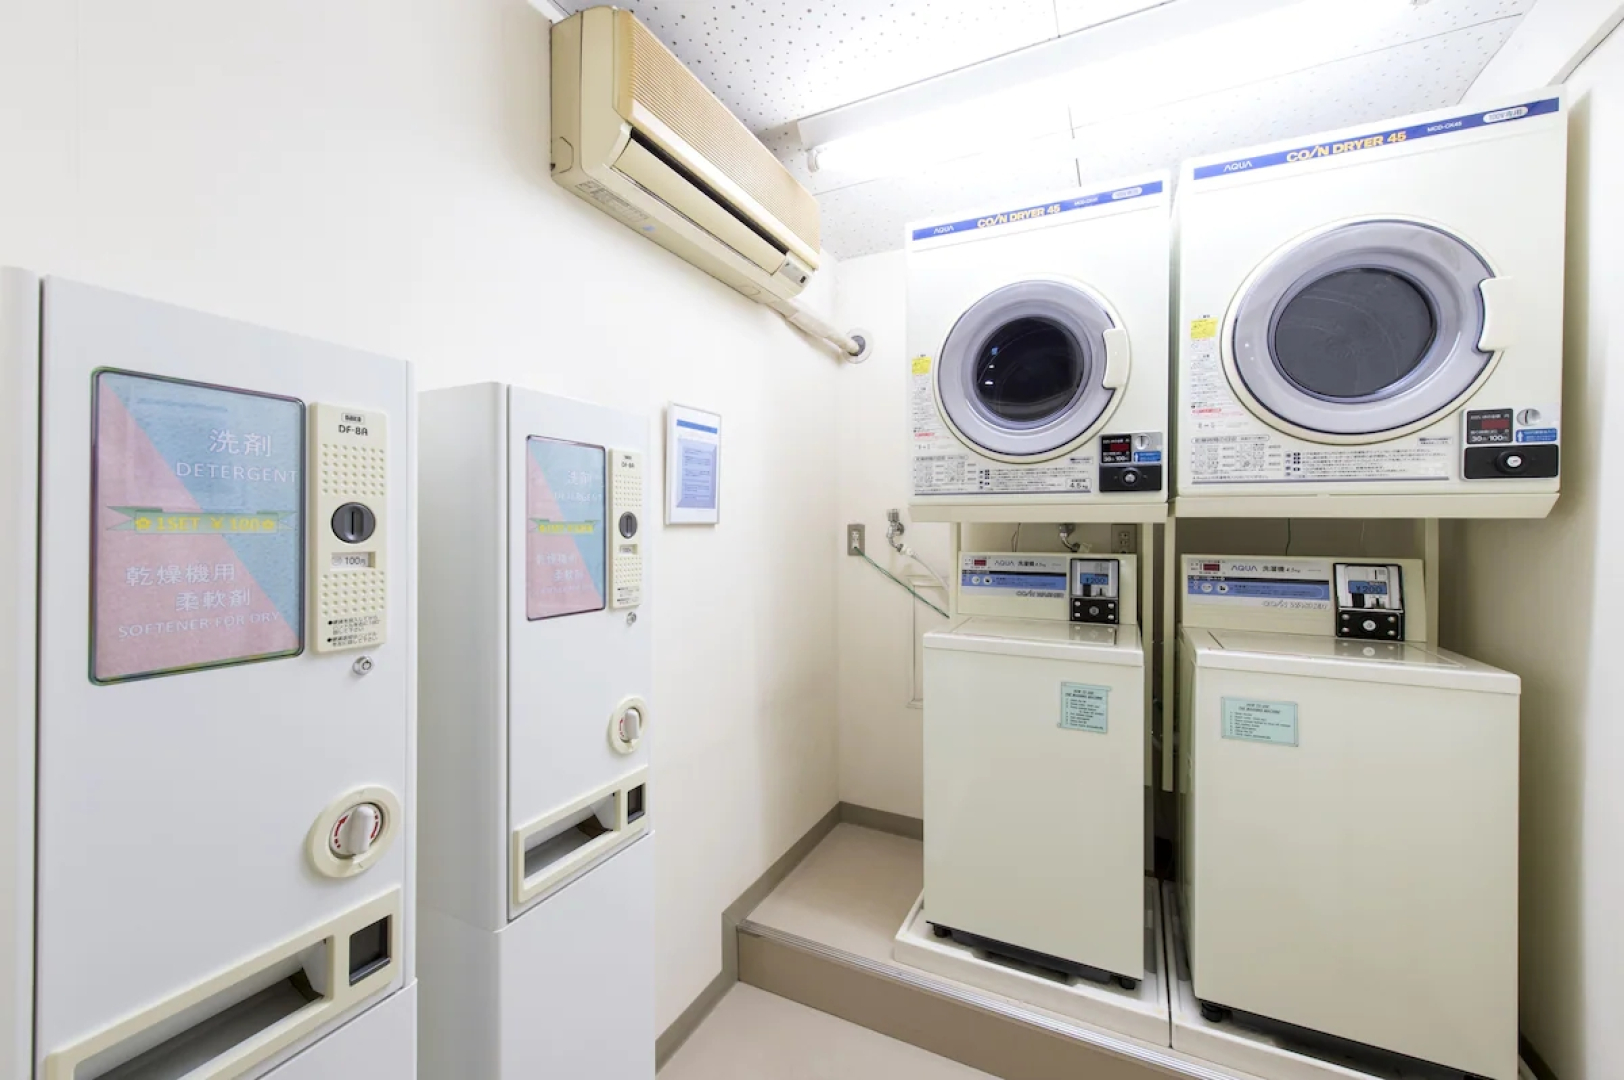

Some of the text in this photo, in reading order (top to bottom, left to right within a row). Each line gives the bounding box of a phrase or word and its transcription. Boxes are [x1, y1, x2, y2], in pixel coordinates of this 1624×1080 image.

[1332, 134, 1384, 154] DRYER
[1387, 131, 1407, 144] 45
[1223, 160, 1253, 173] AQUA
[1009, 207, 1046, 223] DRYER
[1047, 204, 1061, 215] 45
[933, 225, 955, 235] AQUA
[208, 428, 272, 456] 洗剤
[176, 462, 299, 484] DETERGENT
[156, 516, 200, 531] 1SET
[125, 563, 235, 587] 乾燥機用
[175, 588, 250, 612] 柔軟剤
[118, 611, 280, 639] SOFTENER FOR DRY
